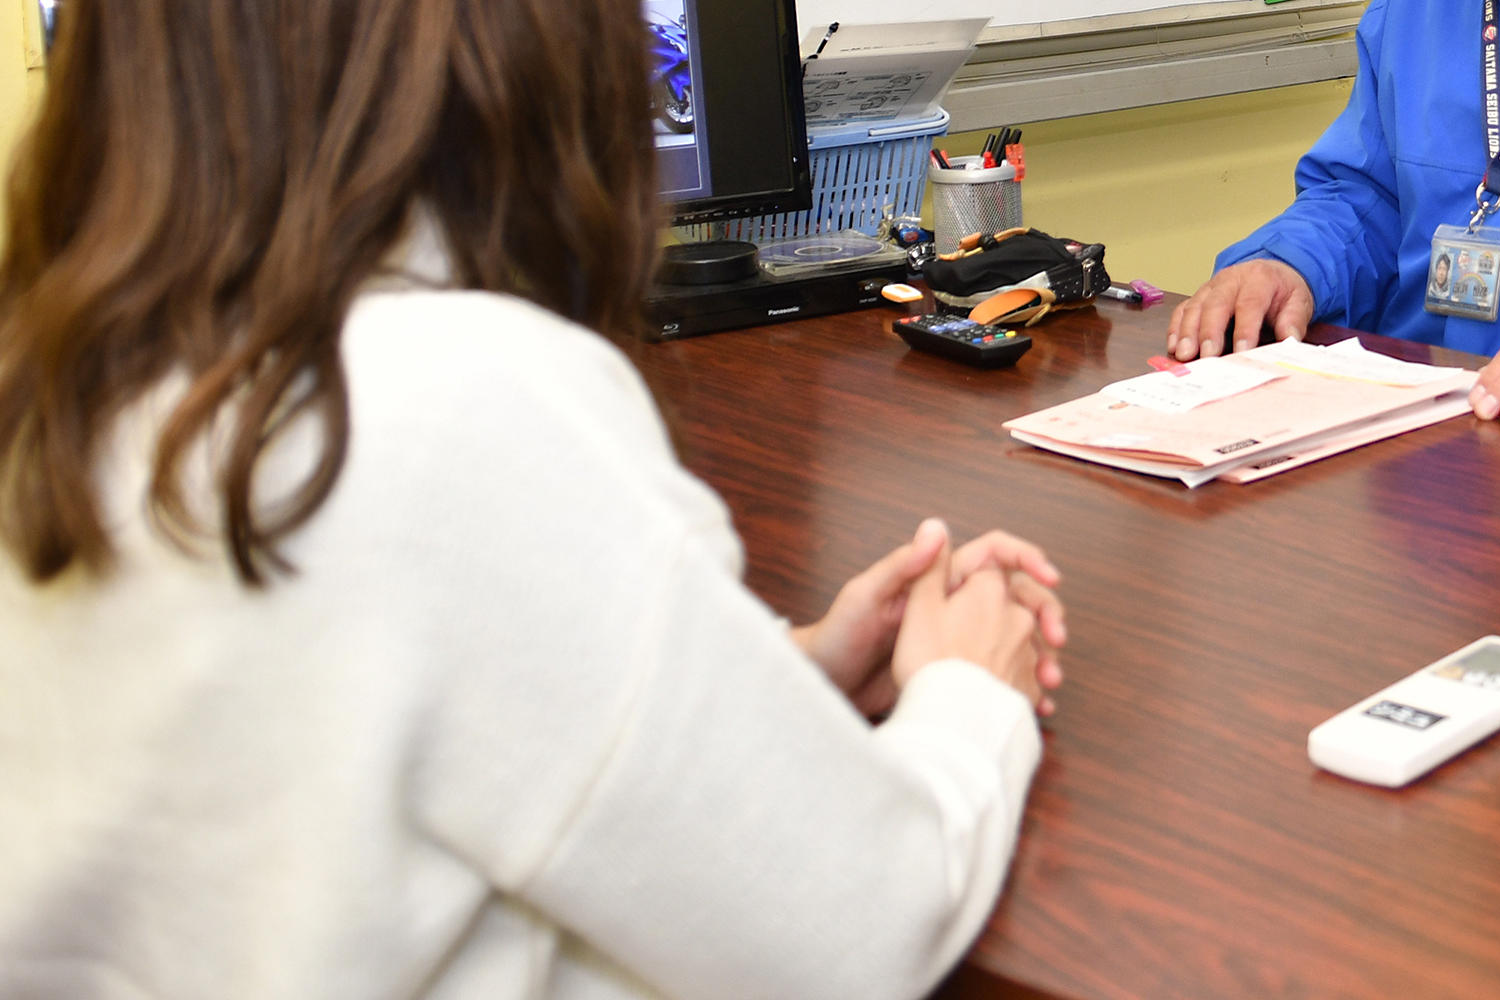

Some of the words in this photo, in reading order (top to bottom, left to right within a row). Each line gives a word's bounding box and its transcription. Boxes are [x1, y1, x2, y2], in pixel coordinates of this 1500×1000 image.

[1485, 43, 1498, 91] SAITAMA
[1486, 93, 1499, 126] SEIBU
[767, 306, 800, 316] Panasonic
